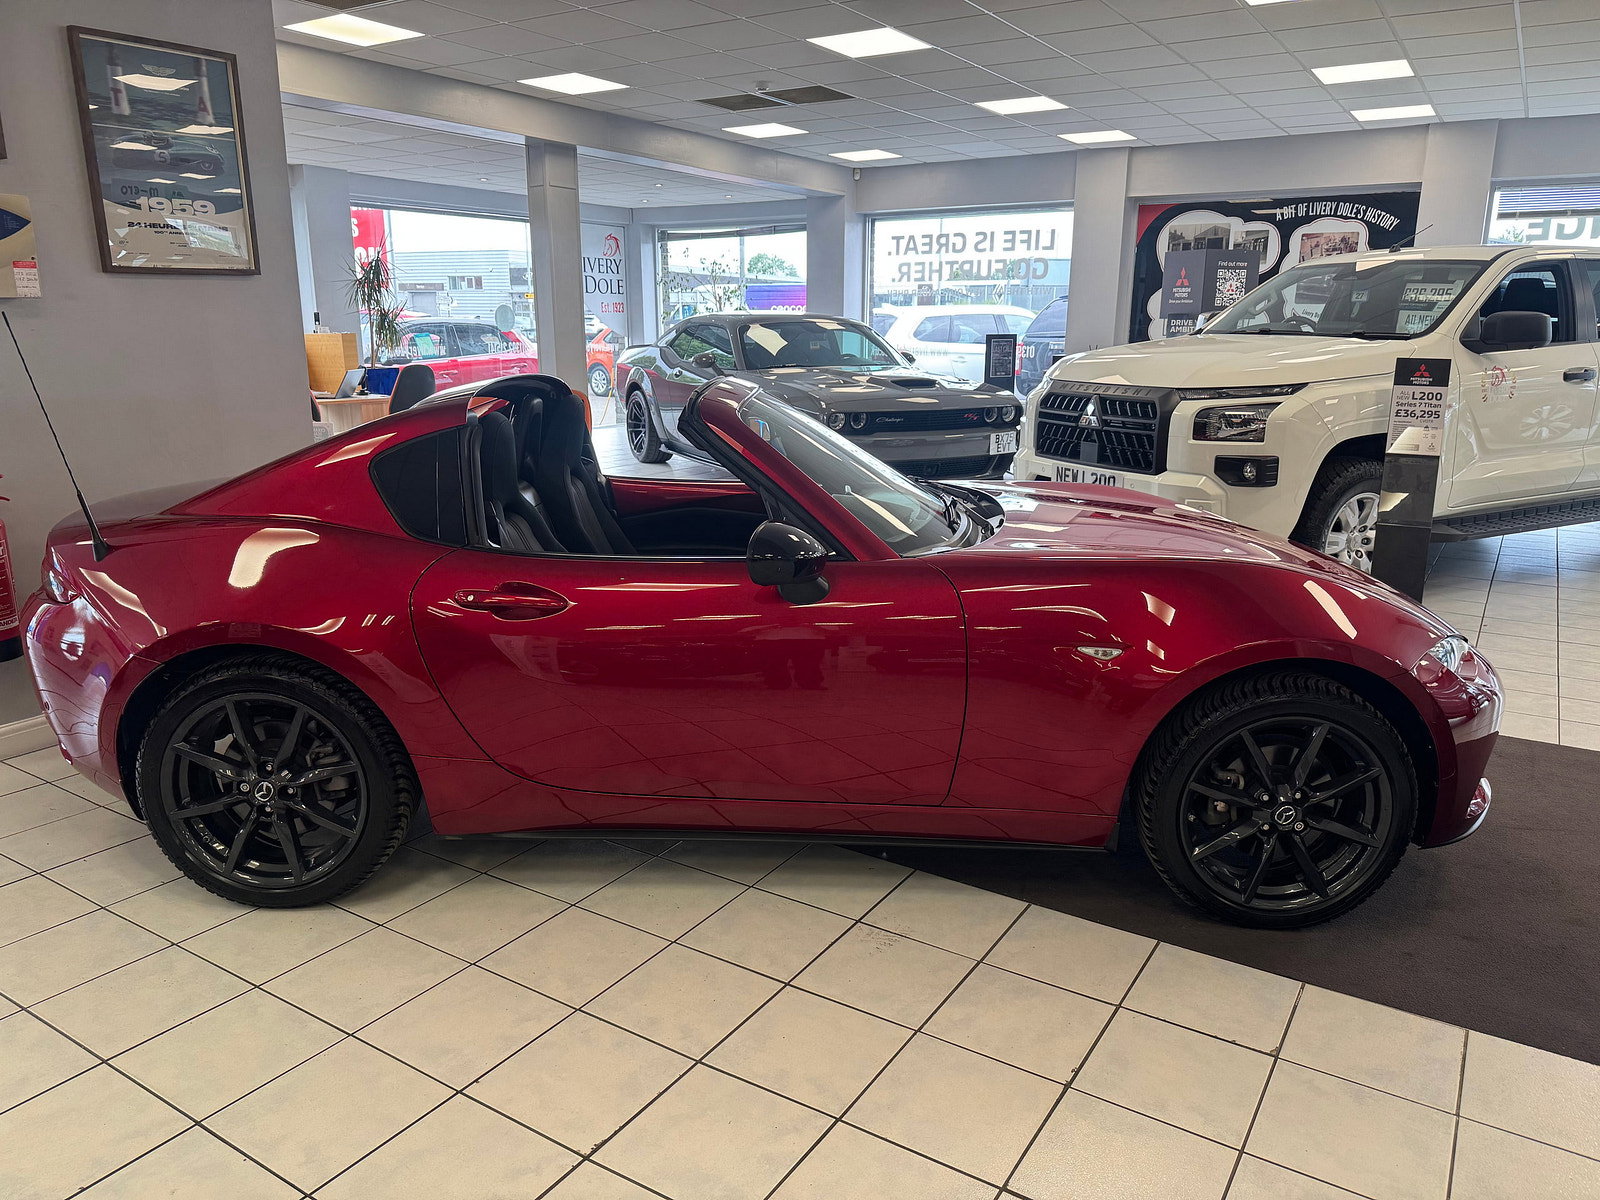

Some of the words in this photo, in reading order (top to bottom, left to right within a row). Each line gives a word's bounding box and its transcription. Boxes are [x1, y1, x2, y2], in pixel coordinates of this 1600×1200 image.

[135, 196, 216, 217] 1959
[1276, 207, 1283, 221] A
[1283, 204, 1297, 220] BIT
[1297, 203, 1308, 217] OF
[1308, 201, 1338, 216] LIVERY
[1337, 201, 1366, 219] DOLE'S
[1364, 206, 1401, 231] HISTORY
[583, 256, 622, 275] IVERY
[584, 275, 624, 295] DOLE
[601, 302, 611, 313] Est.
[612, 302, 625, 314] 1923
[1411, 391, 1443, 401] L200
[1394, 409, 1440, 420] £36,295
[996, 442, 1012, 453] EVT
[1056, 465, 1080, 483] NEW
